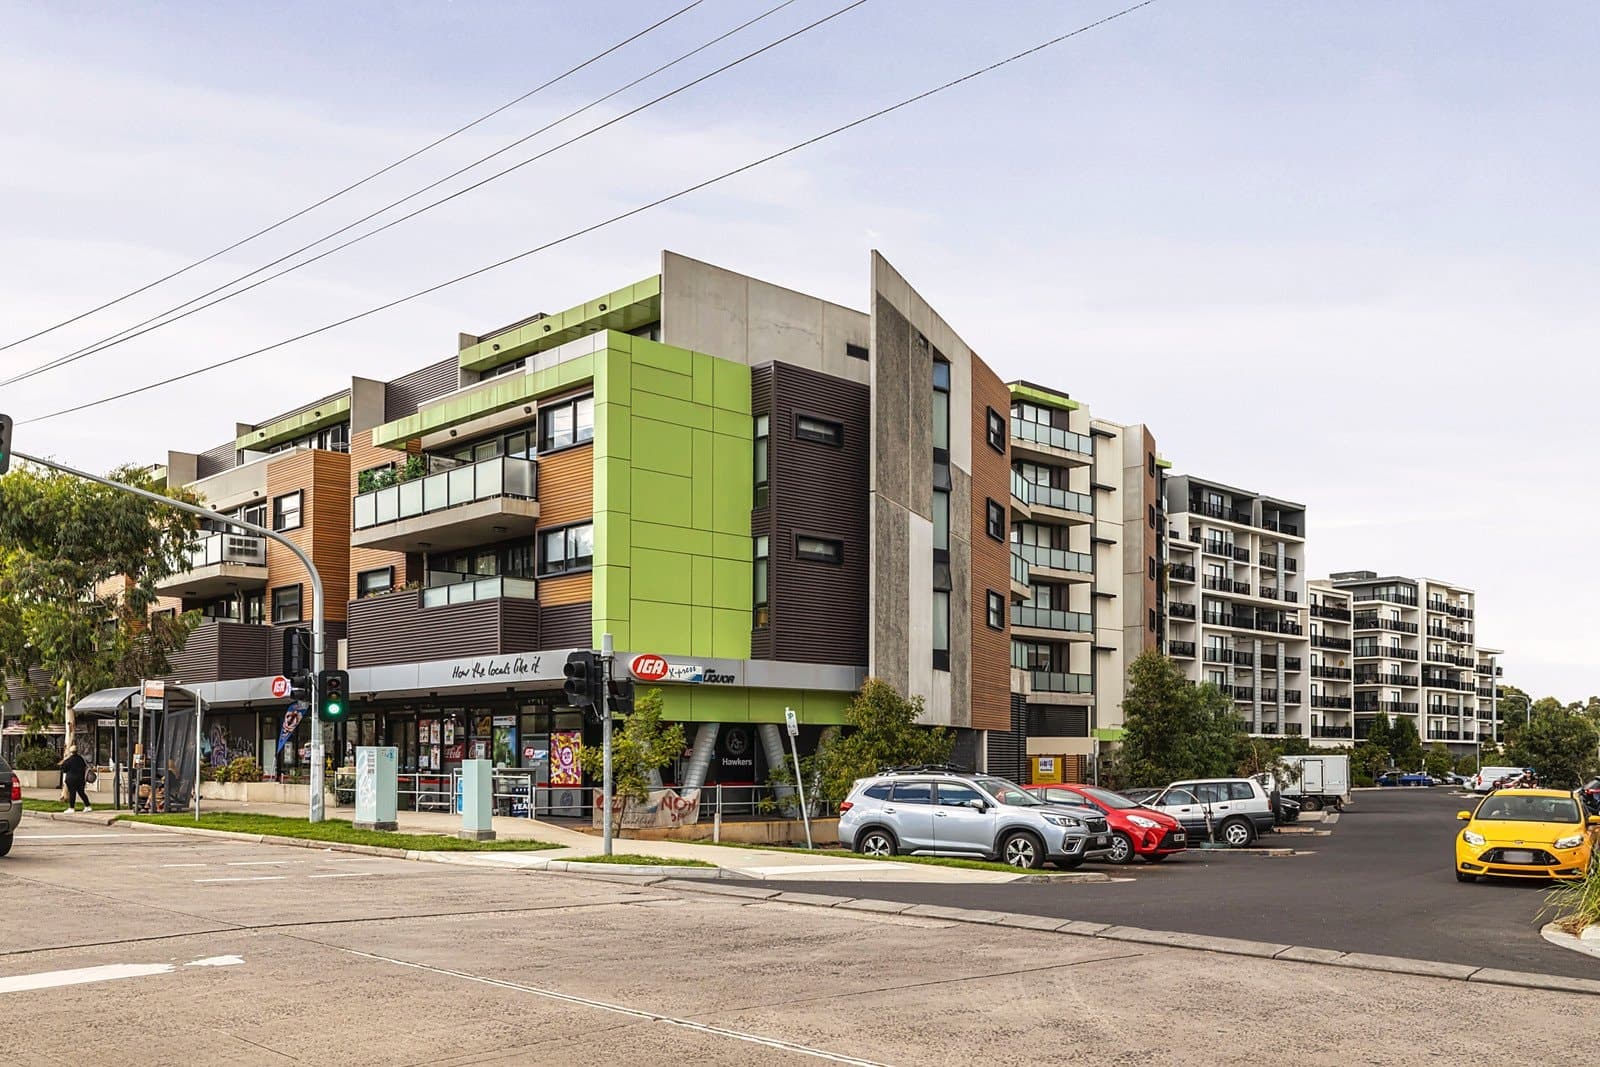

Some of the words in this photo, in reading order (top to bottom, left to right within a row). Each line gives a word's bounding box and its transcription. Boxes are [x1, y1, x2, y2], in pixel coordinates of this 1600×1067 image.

[452, 665, 470, 679] How
[472, 662, 485, 679] the
[488, 660, 511, 676] locals
[513, 657, 528, 674] like
[531, 655, 541, 674] it
[636, 658, 664, 675] IGA
[722, 758, 752, 766] Hawkers
